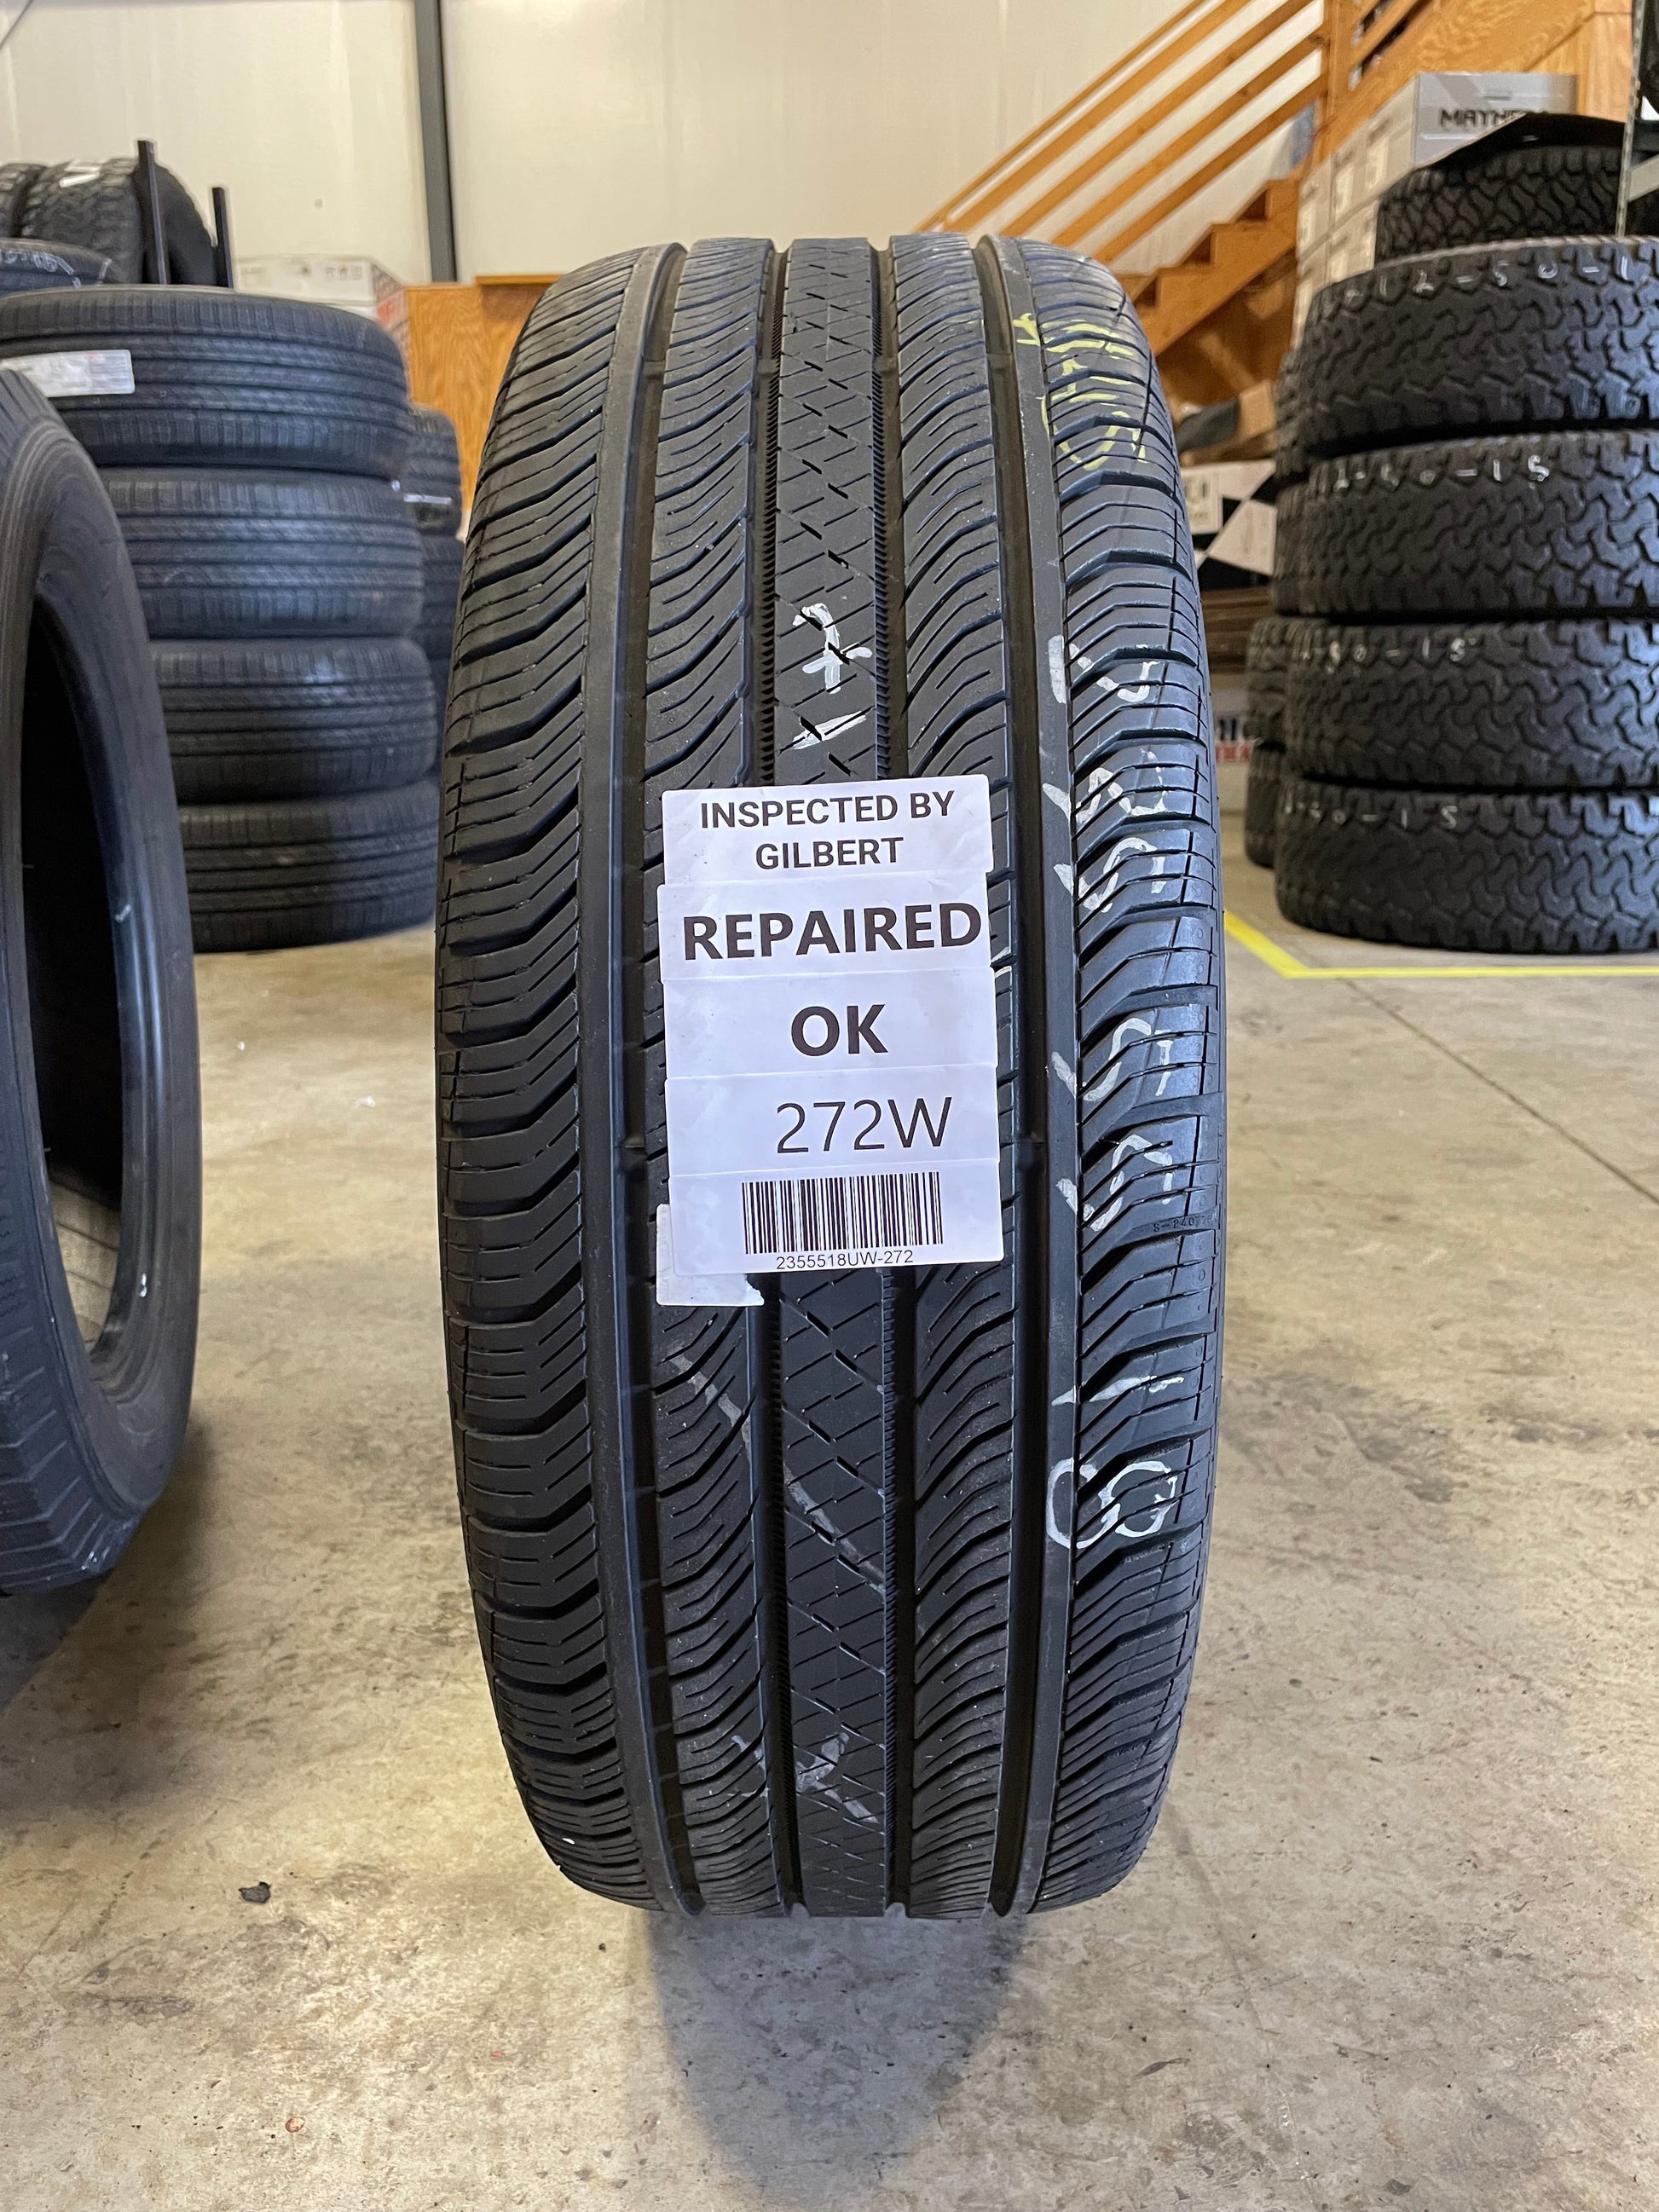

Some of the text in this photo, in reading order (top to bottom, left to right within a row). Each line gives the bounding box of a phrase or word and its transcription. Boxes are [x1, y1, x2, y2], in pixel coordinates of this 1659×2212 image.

[701, 791, 954, 828] INSPECTED BY
[756, 837, 903, 869] GILBERT
[684, 903, 981, 960] REPAIRED
[791, 1004, 887, 1056] OK
[777, 1097, 951, 1153] 272W
[776, 1250, 914, 1270] 2355518UW-272
